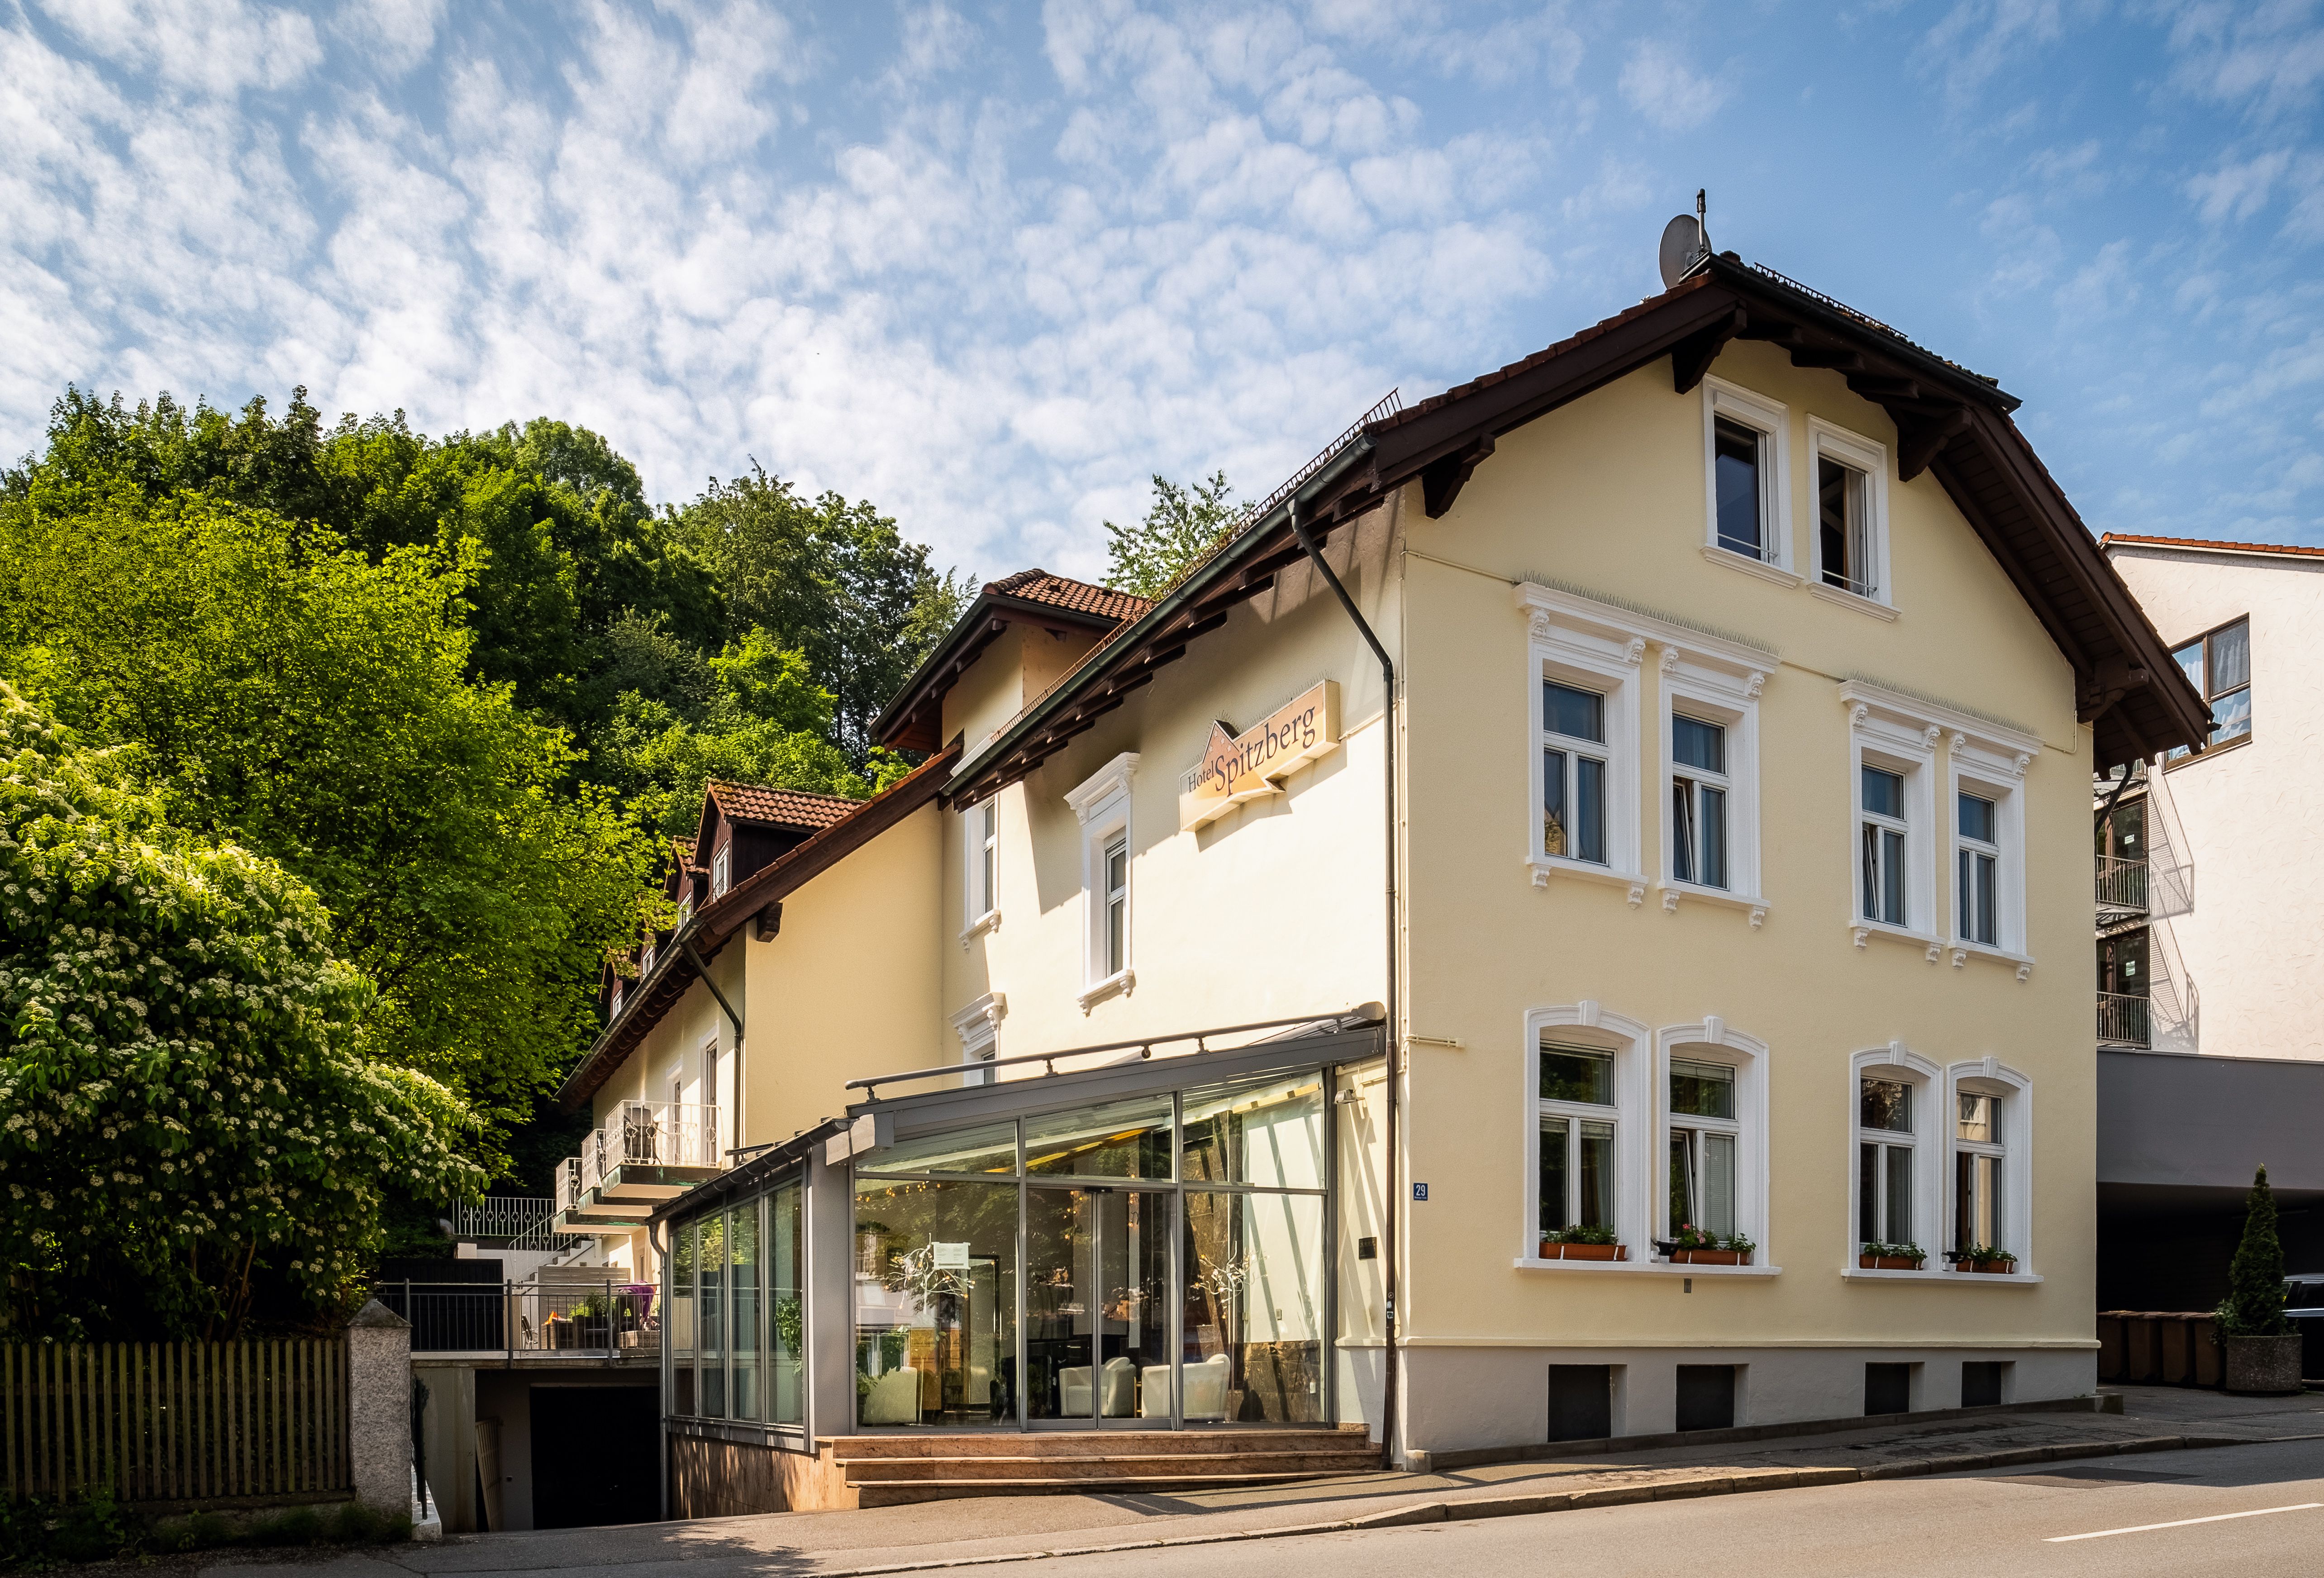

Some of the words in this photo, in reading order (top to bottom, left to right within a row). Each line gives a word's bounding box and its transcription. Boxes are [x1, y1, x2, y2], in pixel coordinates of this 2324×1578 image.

[1188, 760, 1214, 793] Hotel
[1215, 706, 1315, 797] Spitzberg
[1416, 1184, 1425, 1196] 29
